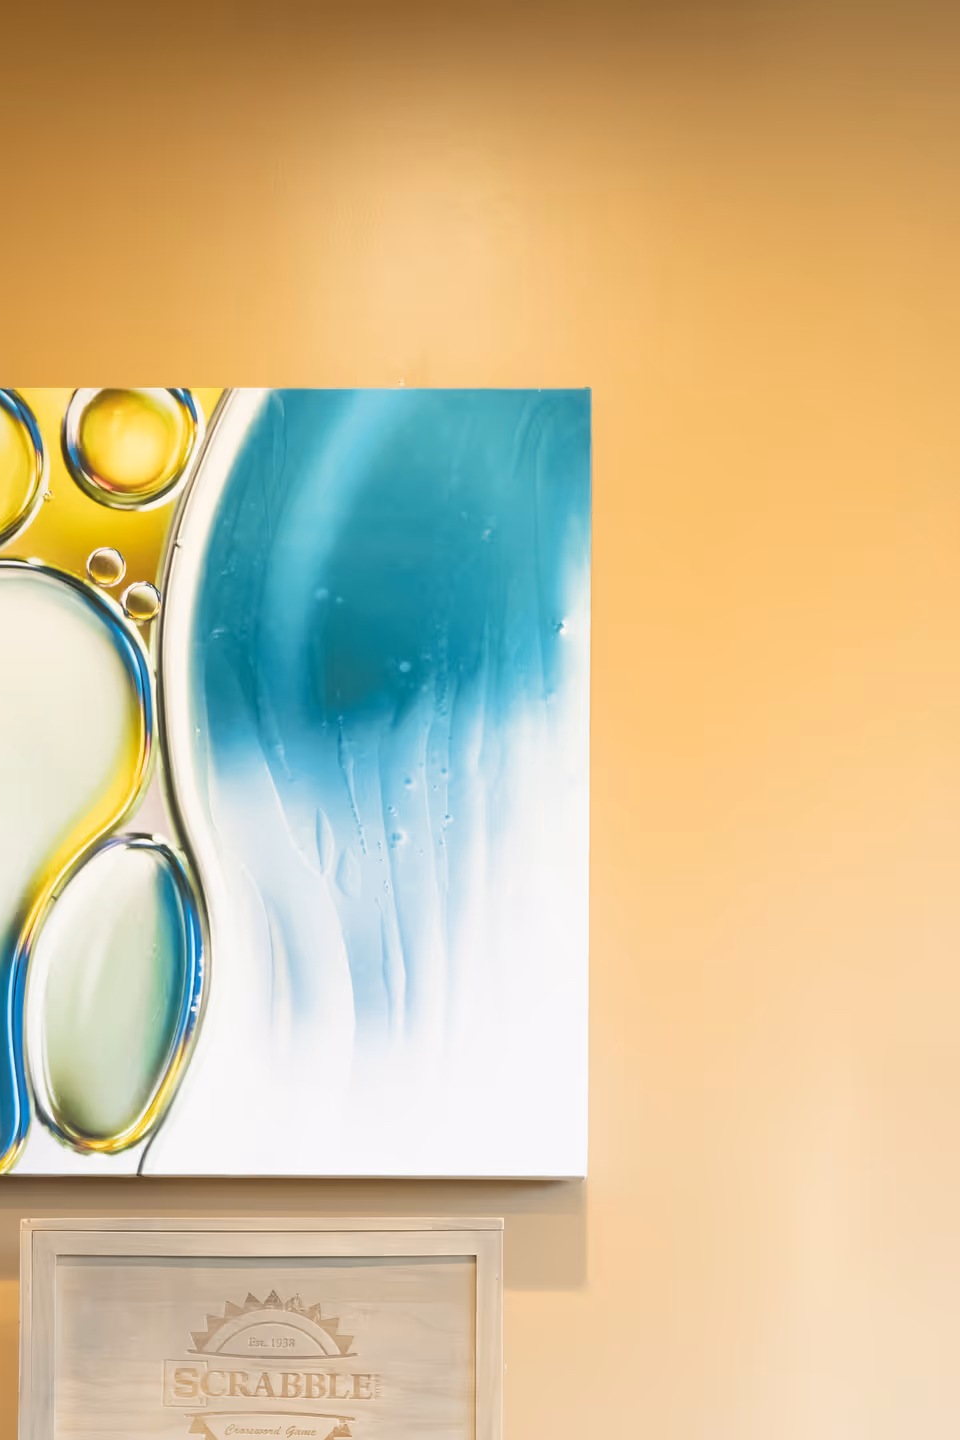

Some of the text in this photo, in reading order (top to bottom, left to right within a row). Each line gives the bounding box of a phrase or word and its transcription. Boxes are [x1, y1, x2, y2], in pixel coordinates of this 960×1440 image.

[174, 1367, 373, 1400] SCRABBLE
[224, 1423, 317, 1438] Crossword Game
